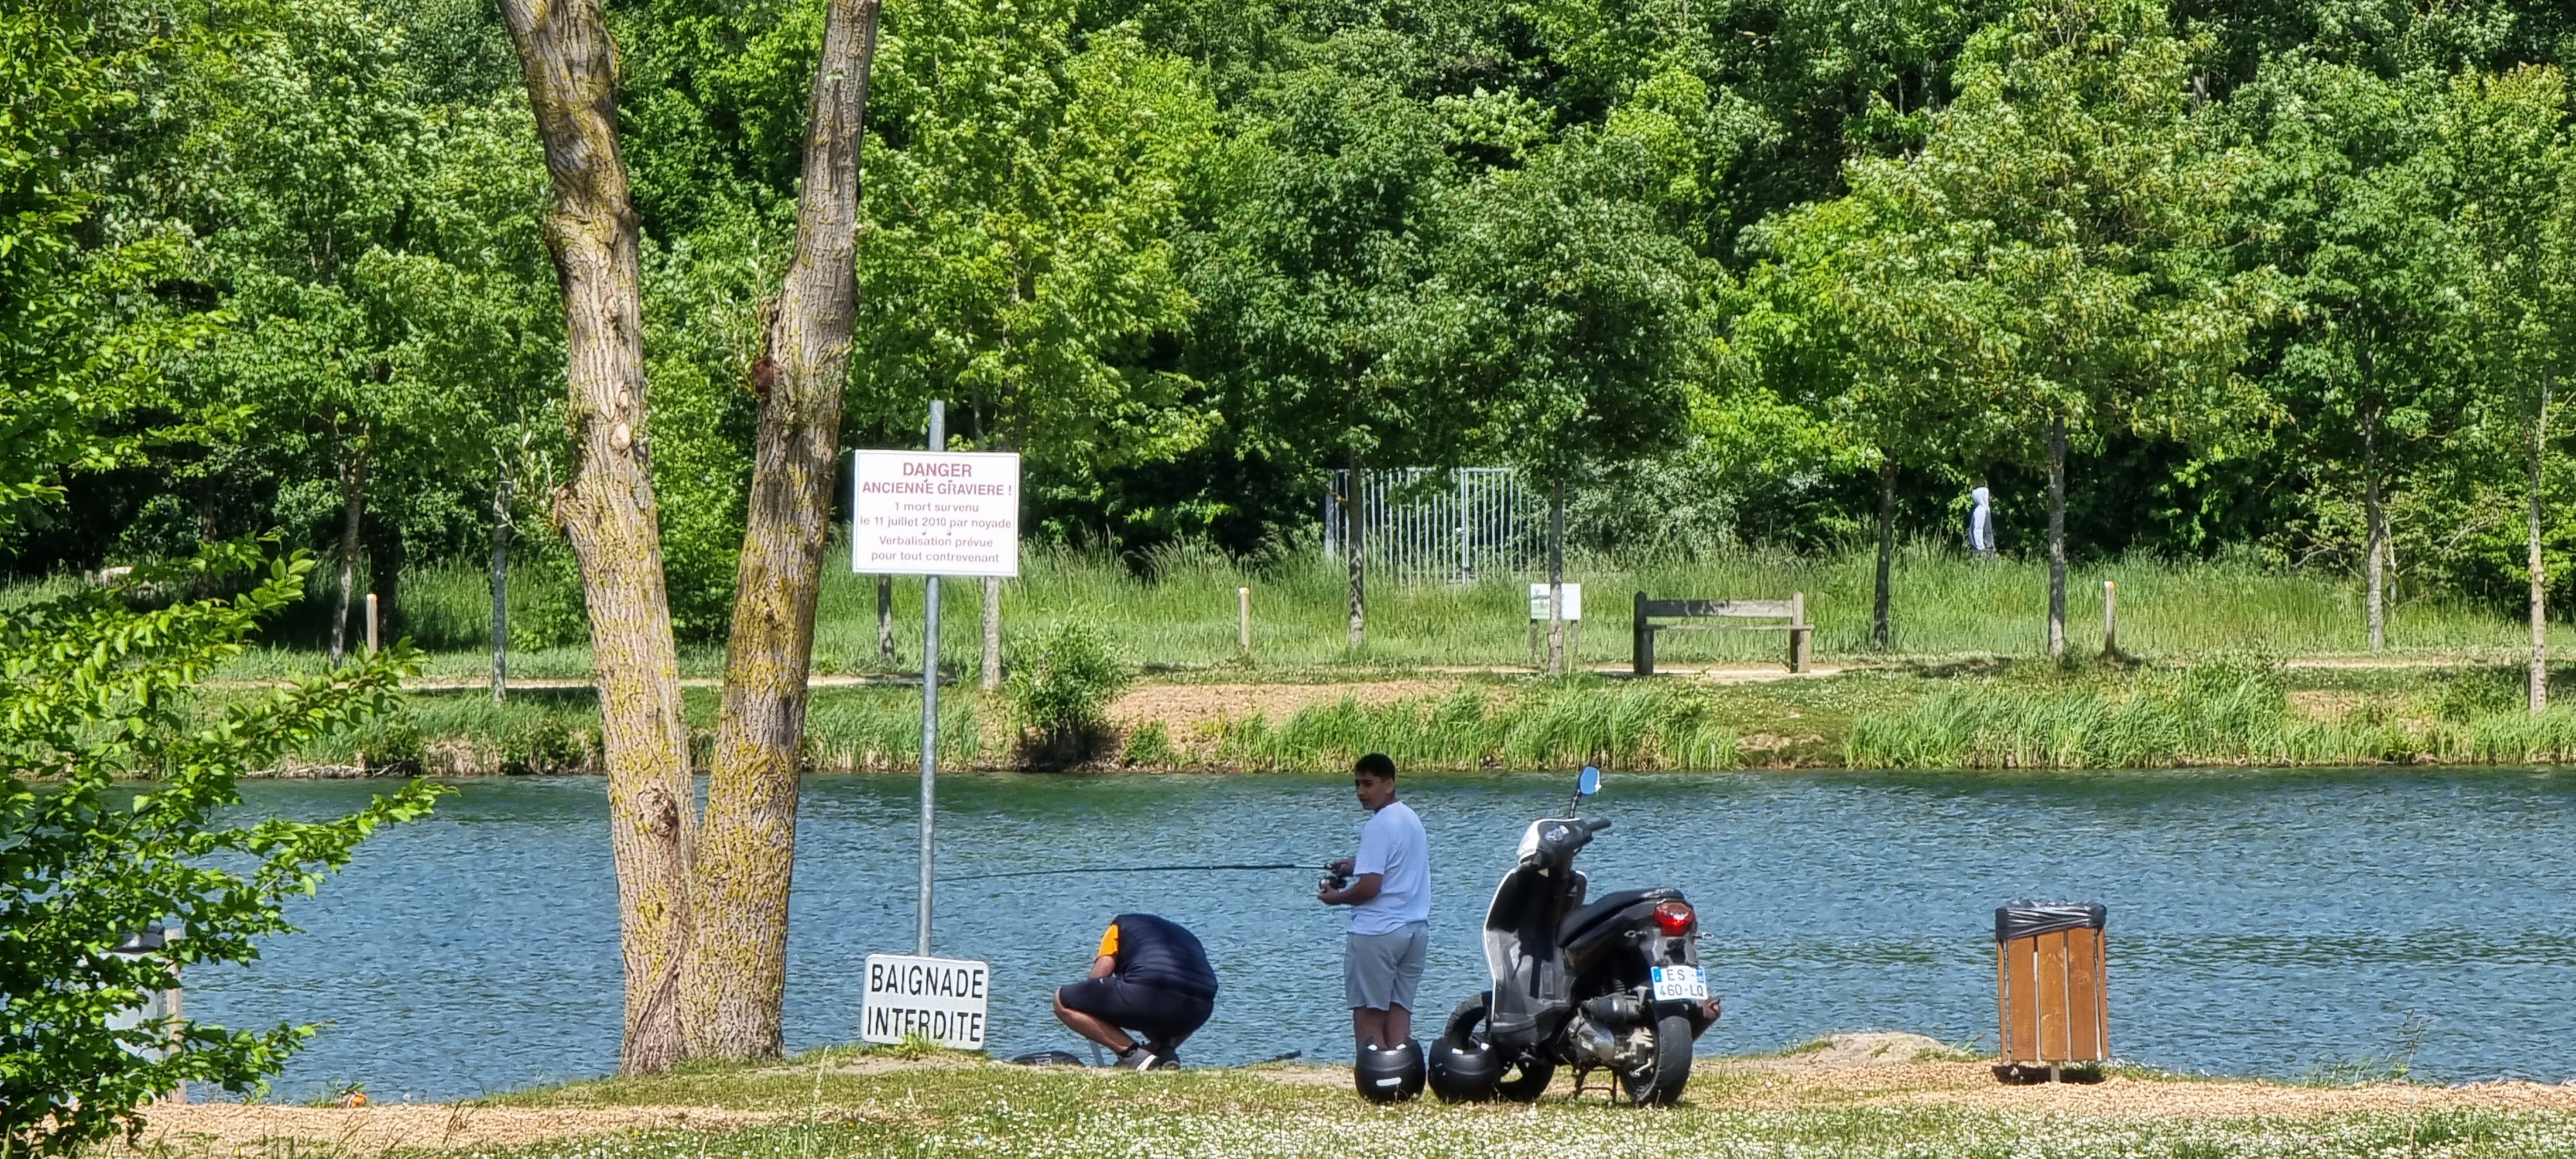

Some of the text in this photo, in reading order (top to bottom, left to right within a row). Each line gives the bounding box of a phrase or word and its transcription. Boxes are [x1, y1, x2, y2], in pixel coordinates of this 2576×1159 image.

[903, 462, 972, 477] DANGER
[862, 482, 1012, 496] ANCIENNE GRAVIERE !
[895, 502, 899, 511] 1
[904, 503, 931, 511] mort
[860, 516, 1011, 530] le 11 juillet 2010 par noyade
[879, 536, 993, 548] Verbalisation prévue
[871, 552, 999, 563] pour tout contrevenant
[871, 964, 984, 999] BAIGNADE
[867, 1006, 982, 1042] INTERDITE
